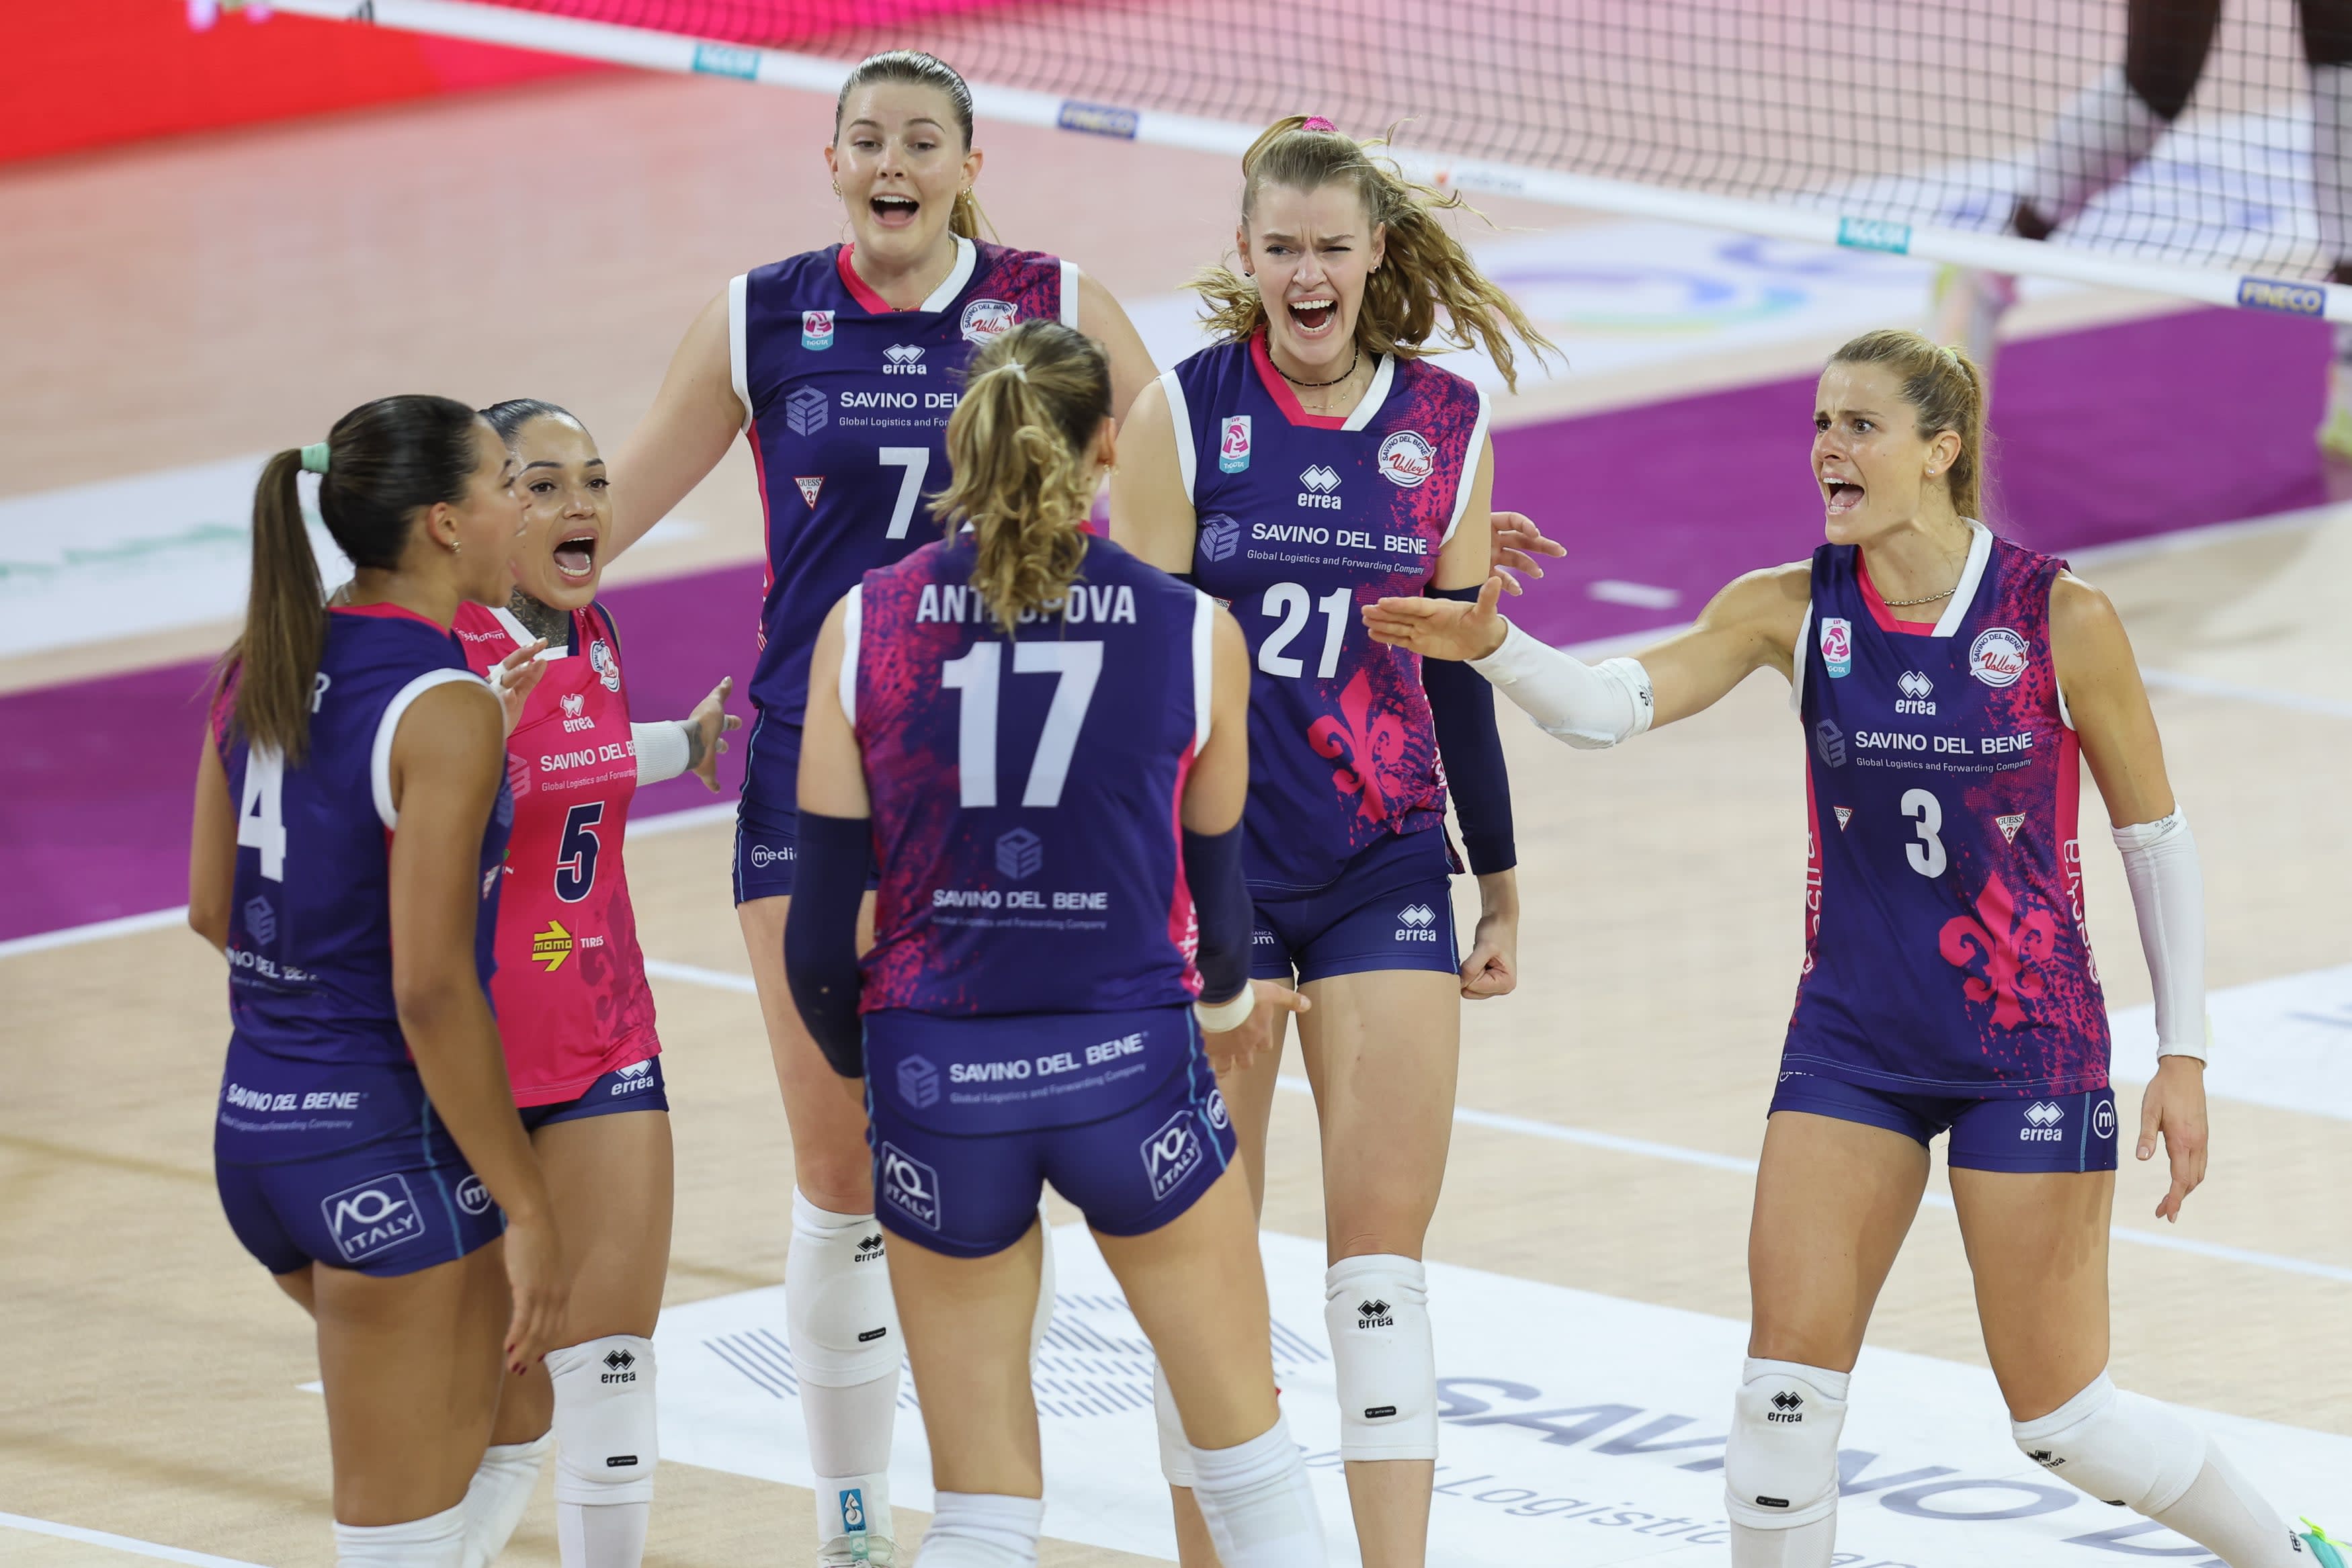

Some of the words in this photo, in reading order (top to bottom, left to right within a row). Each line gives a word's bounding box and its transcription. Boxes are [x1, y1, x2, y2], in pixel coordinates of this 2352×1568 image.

[2241, 281, 2322, 313] FINECO
[965, 306, 978, 328] SAVINO
[841, 391, 917, 408] SAVINO
[925, 393, 962, 408] DEL
[839, 417, 868, 426] Global
[871, 417, 911, 427] Logistics
[914, 418, 931, 427] and
[1382, 438, 1398, 461] SAVINO
[1413, 439, 1428, 455] BENE
[798, 478, 821, 487] GUESS
[878, 447, 930, 539] 7
[1251, 523, 1330, 545] SAVINO
[1336, 529, 1377, 550] DEL
[1384, 534, 1428, 555] BENE
[1247, 550, 1277, 560] Global
[1279, 552, 1320, 564] Logistics
[1322, 557, 1339, 566] and
[1342, 558, 1392, 572] Forwarding
[1394, 563, 1425, 575] Company
[1258, 582, 1352, 679] 21
[1974, 638, 1988, 662] SAVINO
[2004, 634, 2022, 651] BENE
[1981, 652, 2017, 674] Volley
[941, 640, 1104, 808] 17
[1855, 731, 1927, 751] SAVINO
[1934, 736, 1974, 754] DEL
[1981, 732, 2033, 754] BENE
[540, 748, 596, 772] SAVINO
[598, 743, 626, 762] DEL
[1857, 757, 1884, 767] Global
[1886, 758, 1923, 769] Logistics
[1925, 761, 1941, 771] and
[1943, 763, 1994, 773] Forwarding
[1996, 758, 2032, 771] Company
[542, 781, 565, 791] Global
[566, 777, 595, 789] Logistics
[595, 773, 608, 783] and
[237, 736, 286, 883] 4
[1998, 815, 2023, 826] GUESS
[1900, 788, 1947, 878] 3
[554, 801, 605, 903] 5
[933, 889, 1001, 908] SAVINO
[1006, 891, 1047, 908] DEL
[1052, 891, 1108, 910] BENE
[580, 936, 604, 948] TIRES
[950, 1059, 1032, 1083] SAVINO
[1036, 1051, 1081, 1076] DEL
[1085, 1033, 1144, 1065] BENE
[270, 1093, 298, 1112] DEL
[301, 1092, 360, 1109] BENE
[1157, 1141, 1195, 1192] ITALY
[344, 1213, 414, 1248] ITALY
[1431, 1473, 1732, 1545] Logistic
